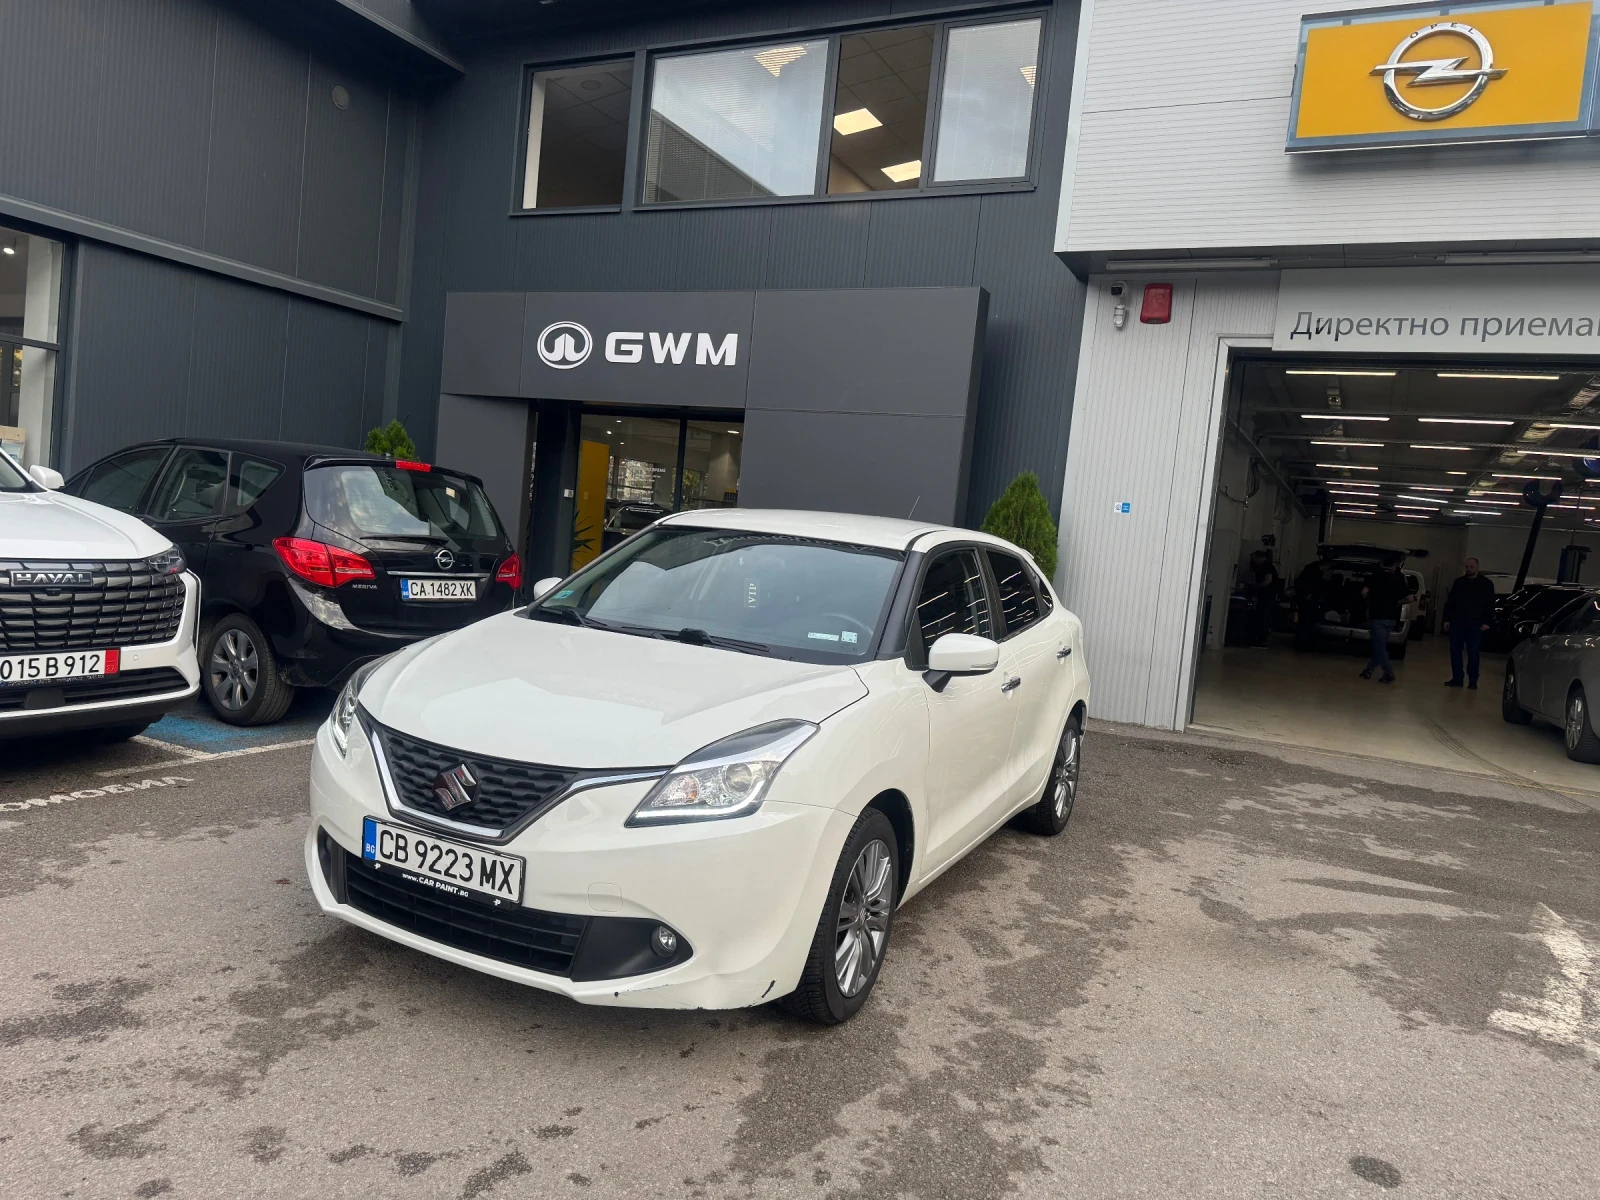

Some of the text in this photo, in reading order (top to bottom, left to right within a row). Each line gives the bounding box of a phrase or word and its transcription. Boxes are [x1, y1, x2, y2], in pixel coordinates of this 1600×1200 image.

[1409, 22, 1475, 39] OPEL
[1290, 311, 1450, 342] Директно
[605, 331, 738, 366] GWM
[16, 573, 91, 584] HAVAL
[410, 582, 474, 597] CA 1482 XK
[0, 654, 100, 680] 015 B 912
[365, 843, 376, 853] BG
[379, 829, 515, 895] CB 9223 MX
